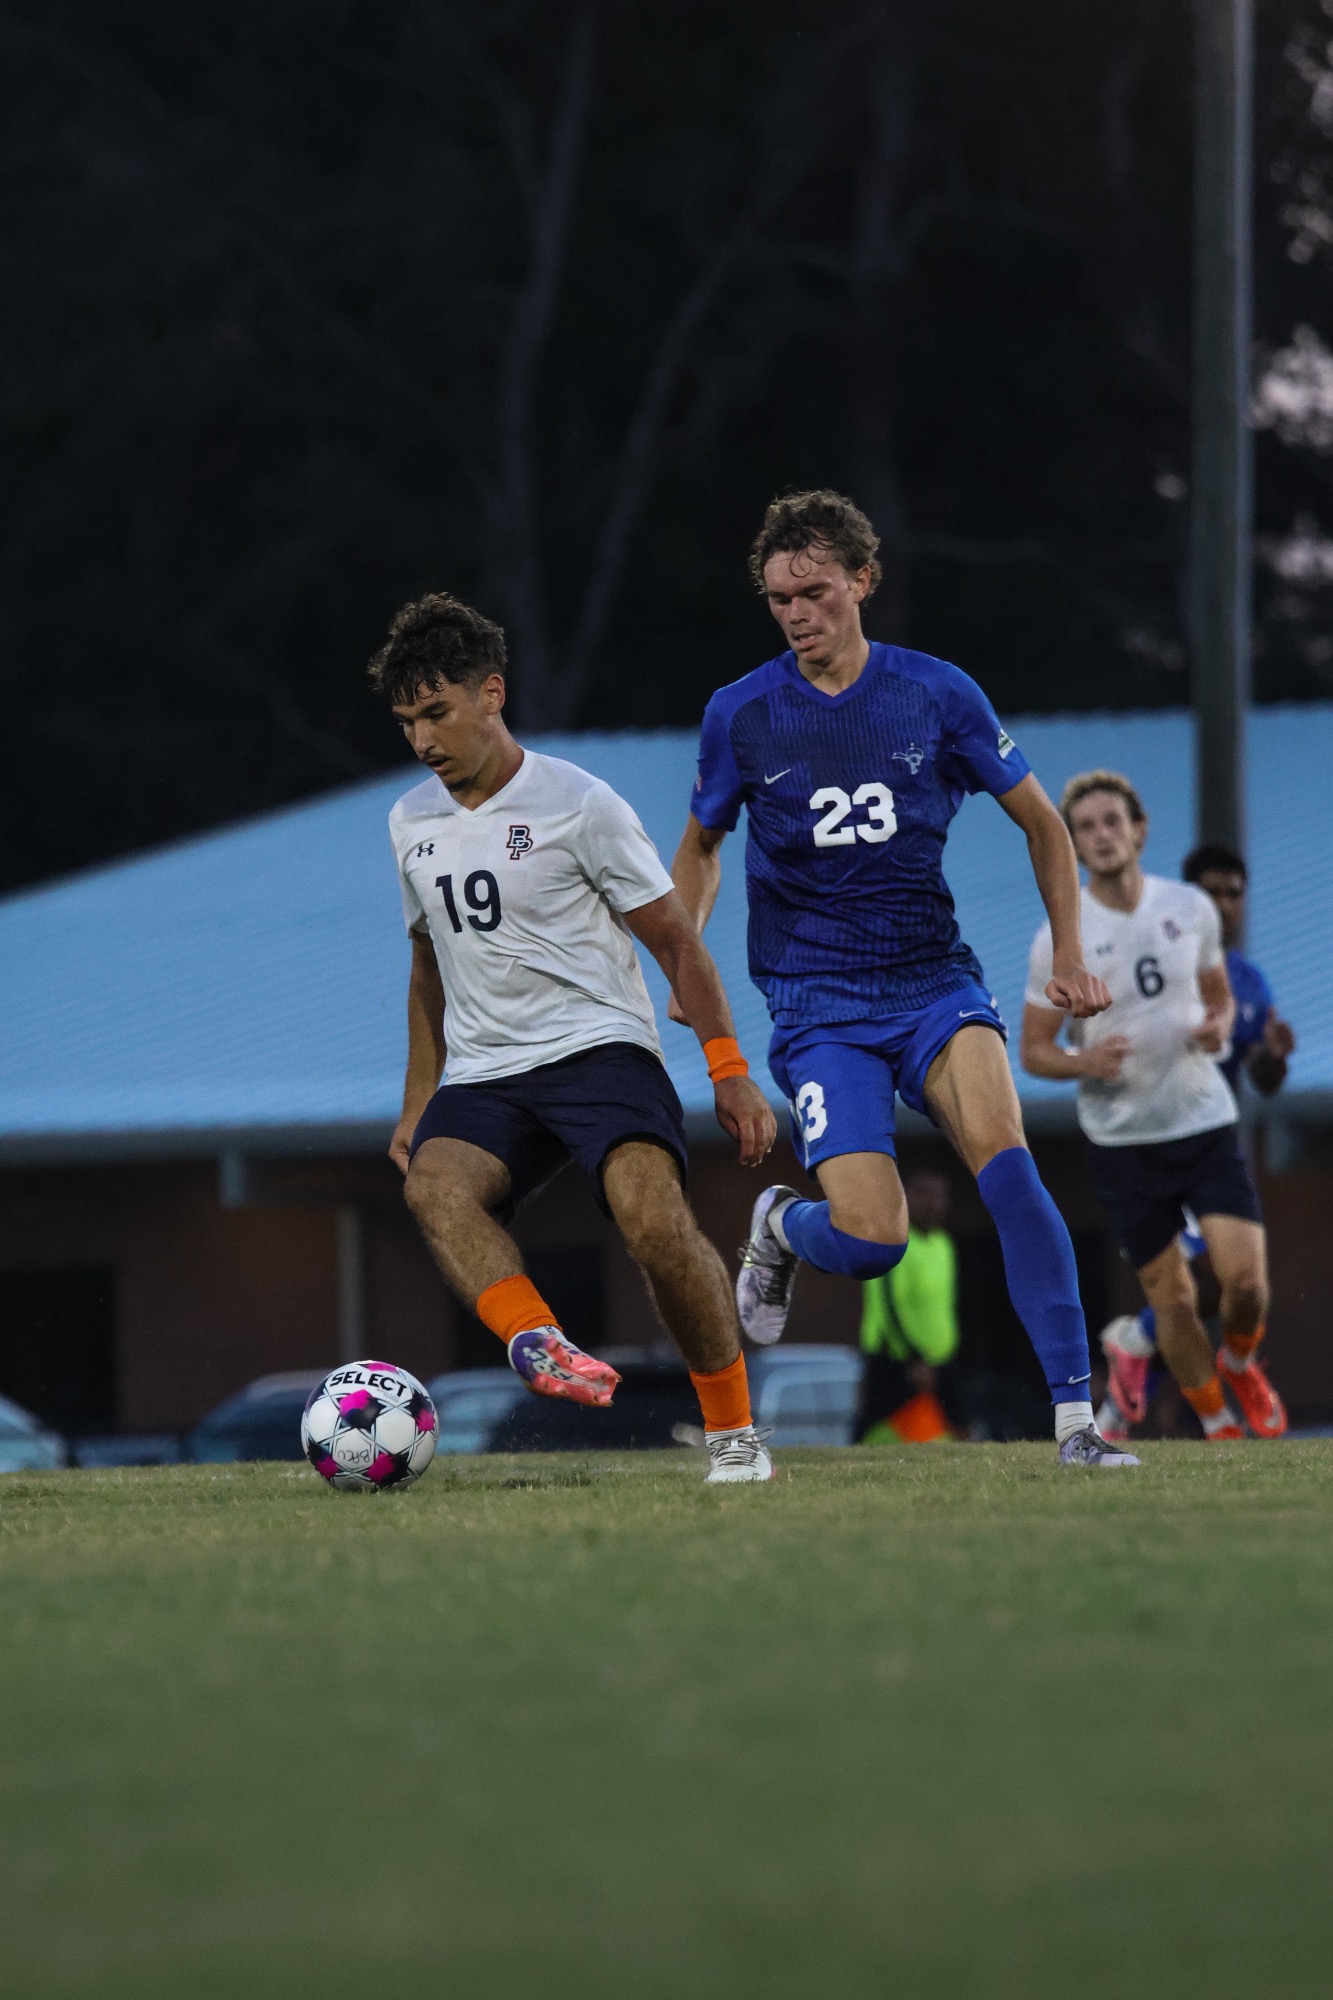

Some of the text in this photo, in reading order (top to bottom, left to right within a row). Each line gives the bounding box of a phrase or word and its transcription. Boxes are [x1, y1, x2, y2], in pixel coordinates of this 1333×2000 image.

[809, 782, 898, 848] 23
[434, 869, 502, 934] 19
[1135, 956, 1165, 998] 6
[790, 1081, 828, 1143] 3
[329, 1370, 407, 1398] SELECT
